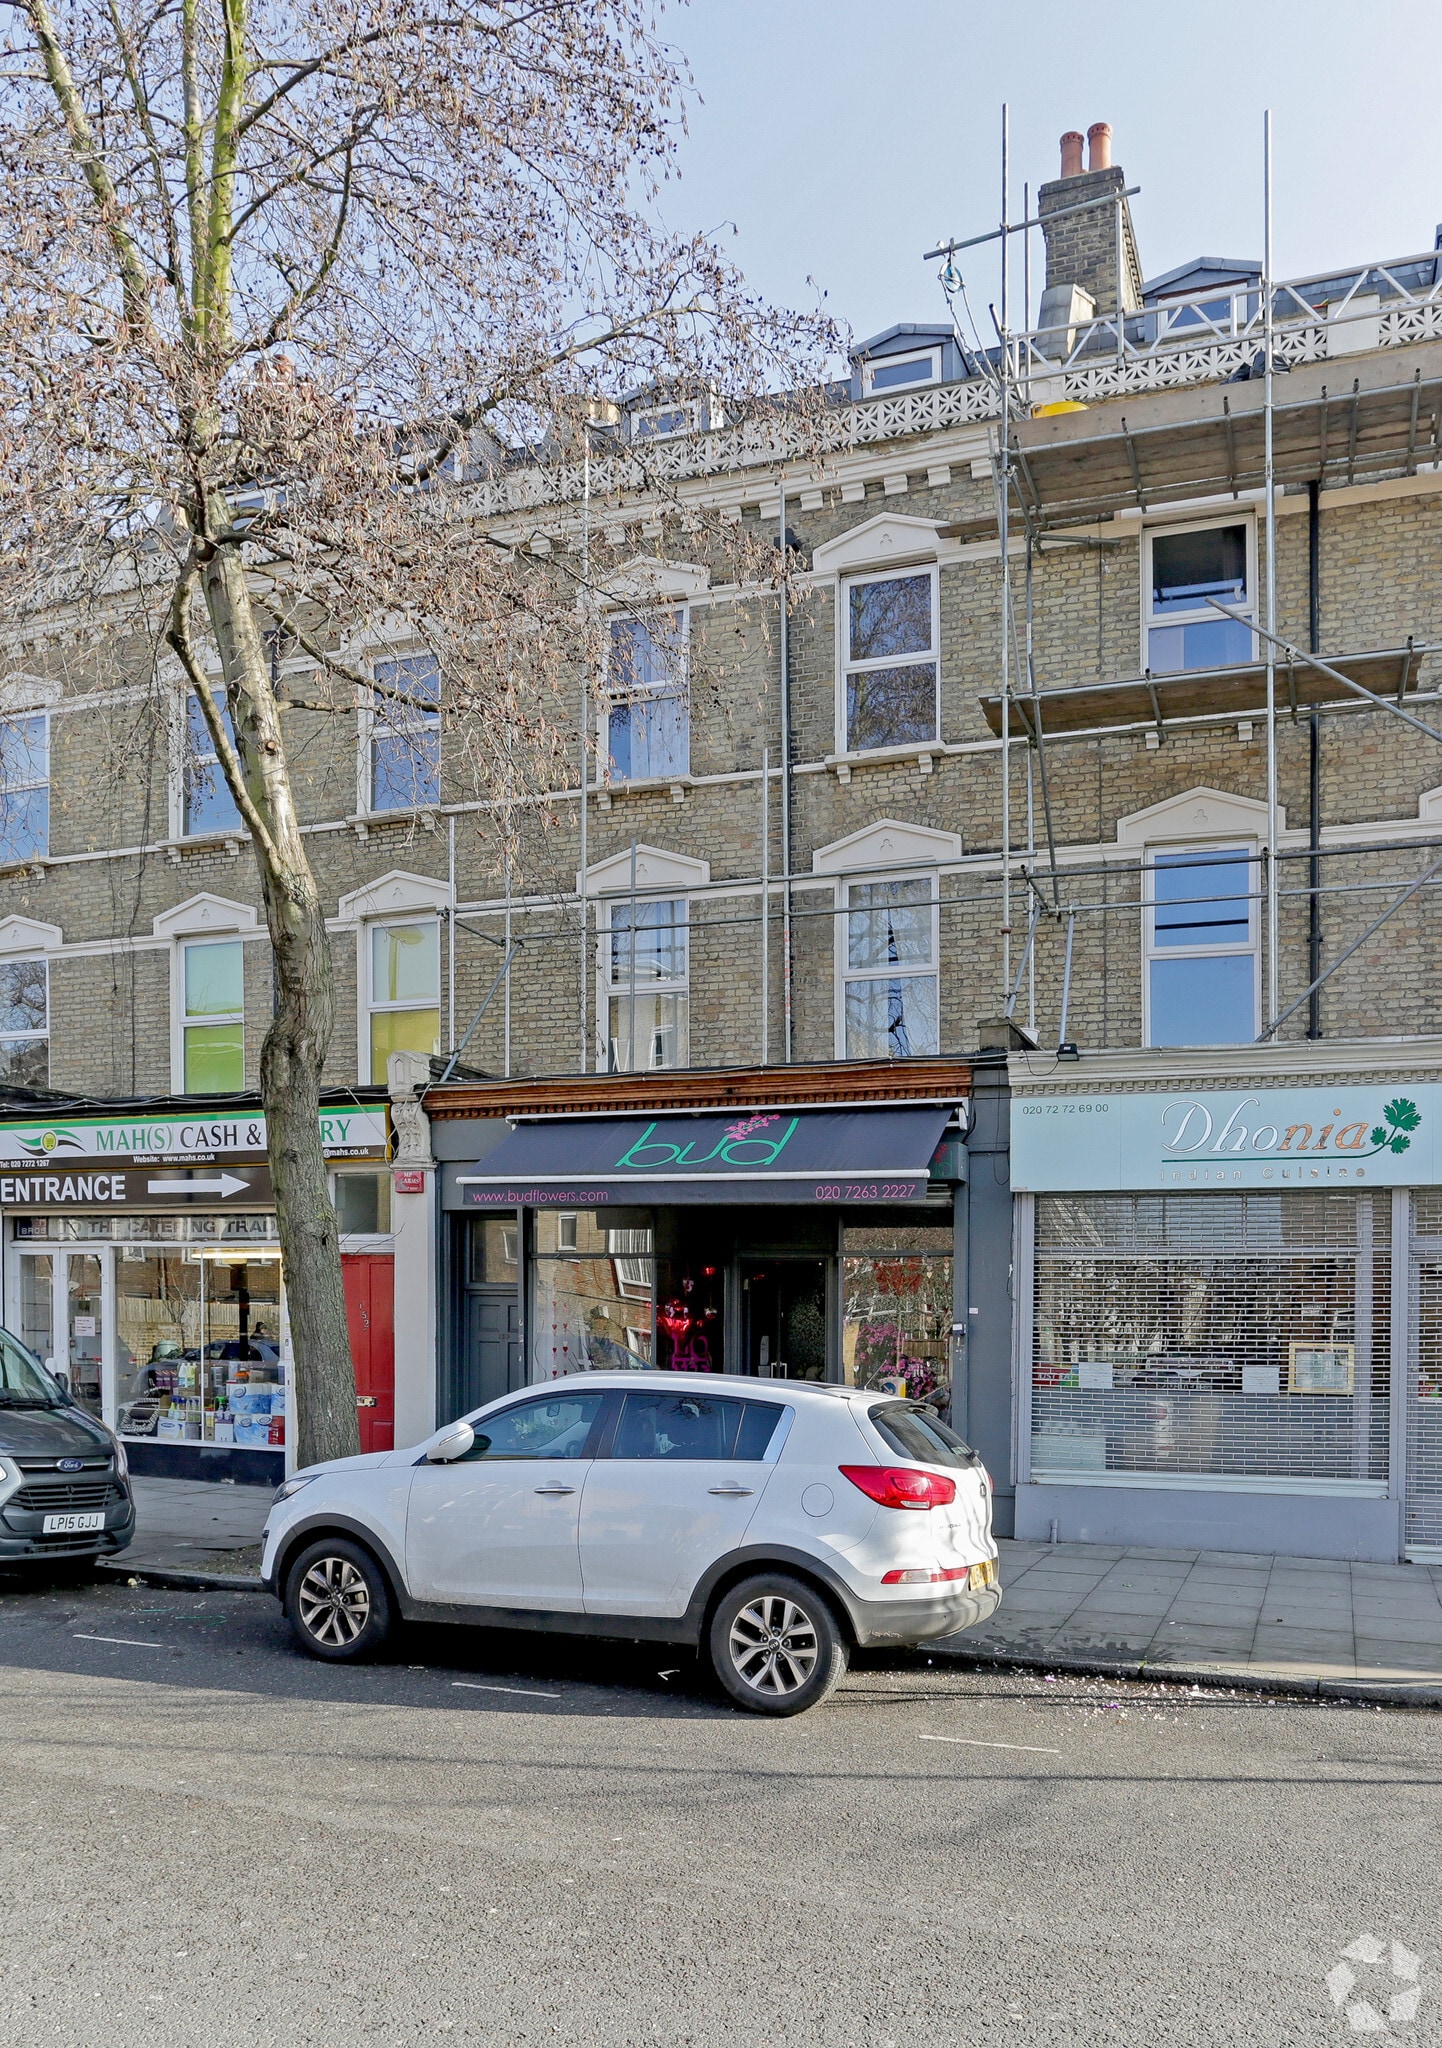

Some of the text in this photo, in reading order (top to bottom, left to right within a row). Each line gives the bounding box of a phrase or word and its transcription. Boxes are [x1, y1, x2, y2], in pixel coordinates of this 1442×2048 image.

[1022, 1103, 1109, 1115] 020 72 72 69 00
[1161, 1097, 1369, 1154] Dhonia
[96, 1123, 263, 1152] MAH(S) CASH &
[614, 1117, 800, 1168] bud
[133, 1153, 216, 1164] Website: www.mahs.co.uk
[323, 1147, 369, 1158] @mahs.co.uk
[1160, 1166, 1367, 1181] Indian Cuisine
[1, 1175, 126, 1203] ENTRANCE
[472, 1189, 609, 1203] www.budflowers.com
[815, 1184, 916, 1200] 020 7263 2227
[128, 1219, 216, 1234] CATERNG
[225, 1218, 280, 1234] TRAD
[63, 1460, 79, 1469] Ford
[50, 1515, 98, 1529] LP15 GJJ
